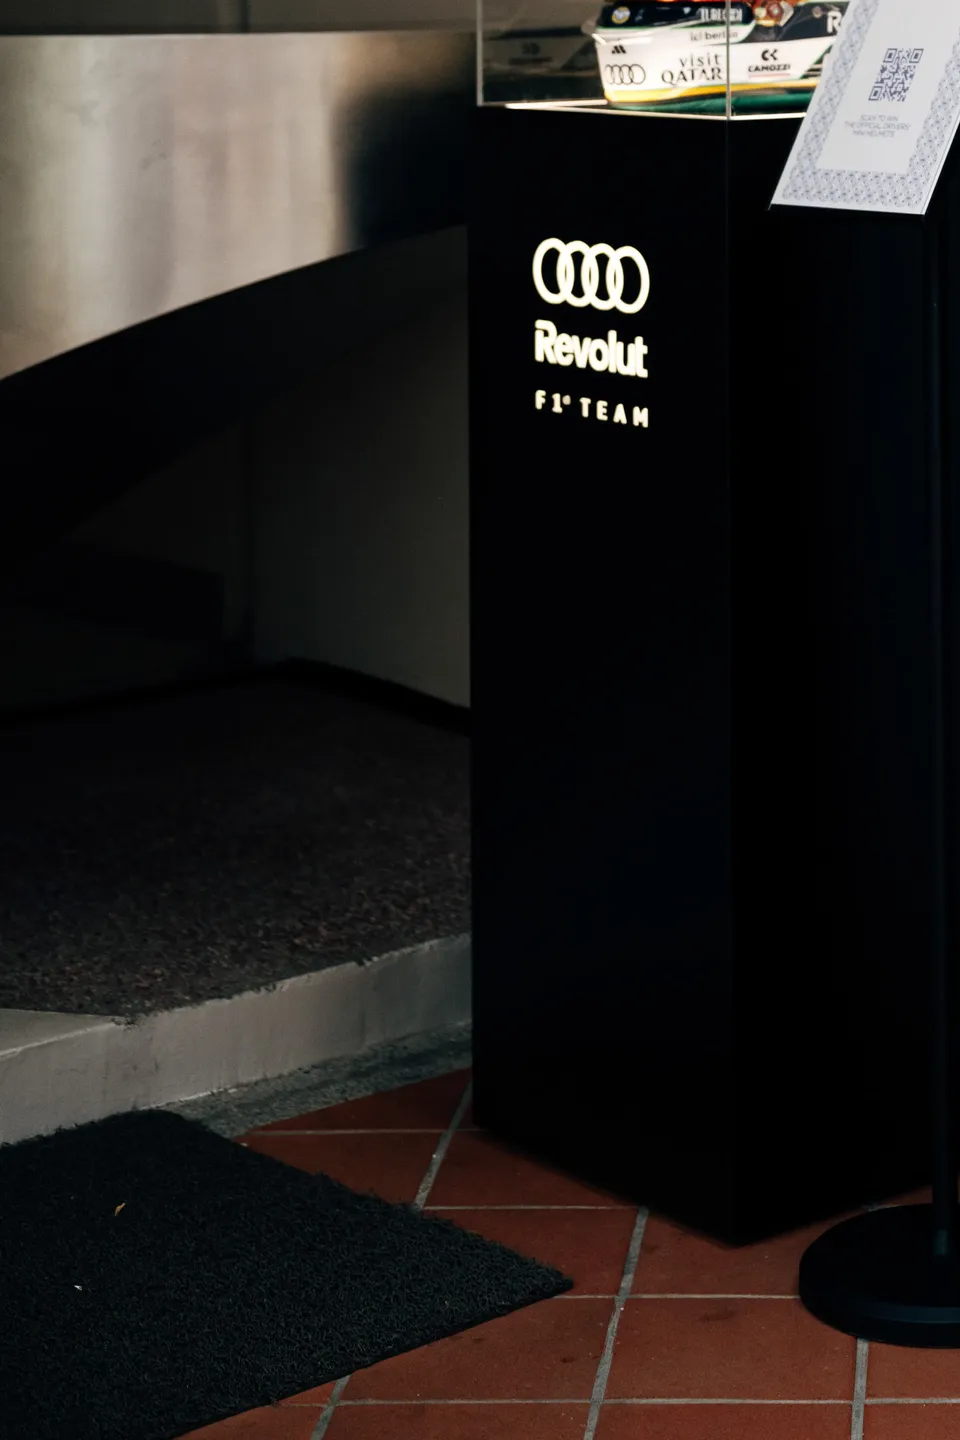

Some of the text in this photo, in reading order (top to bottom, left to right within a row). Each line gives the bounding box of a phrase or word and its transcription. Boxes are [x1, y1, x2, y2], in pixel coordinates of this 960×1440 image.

[680, 53, 722, 68] visit
[748, 64, 791, 73] CAMOZZI
[661, 67, 723, 86] QATAR
[534, 318, 649, 379] Revolut
[579, 396, 649, 428] TEAM
